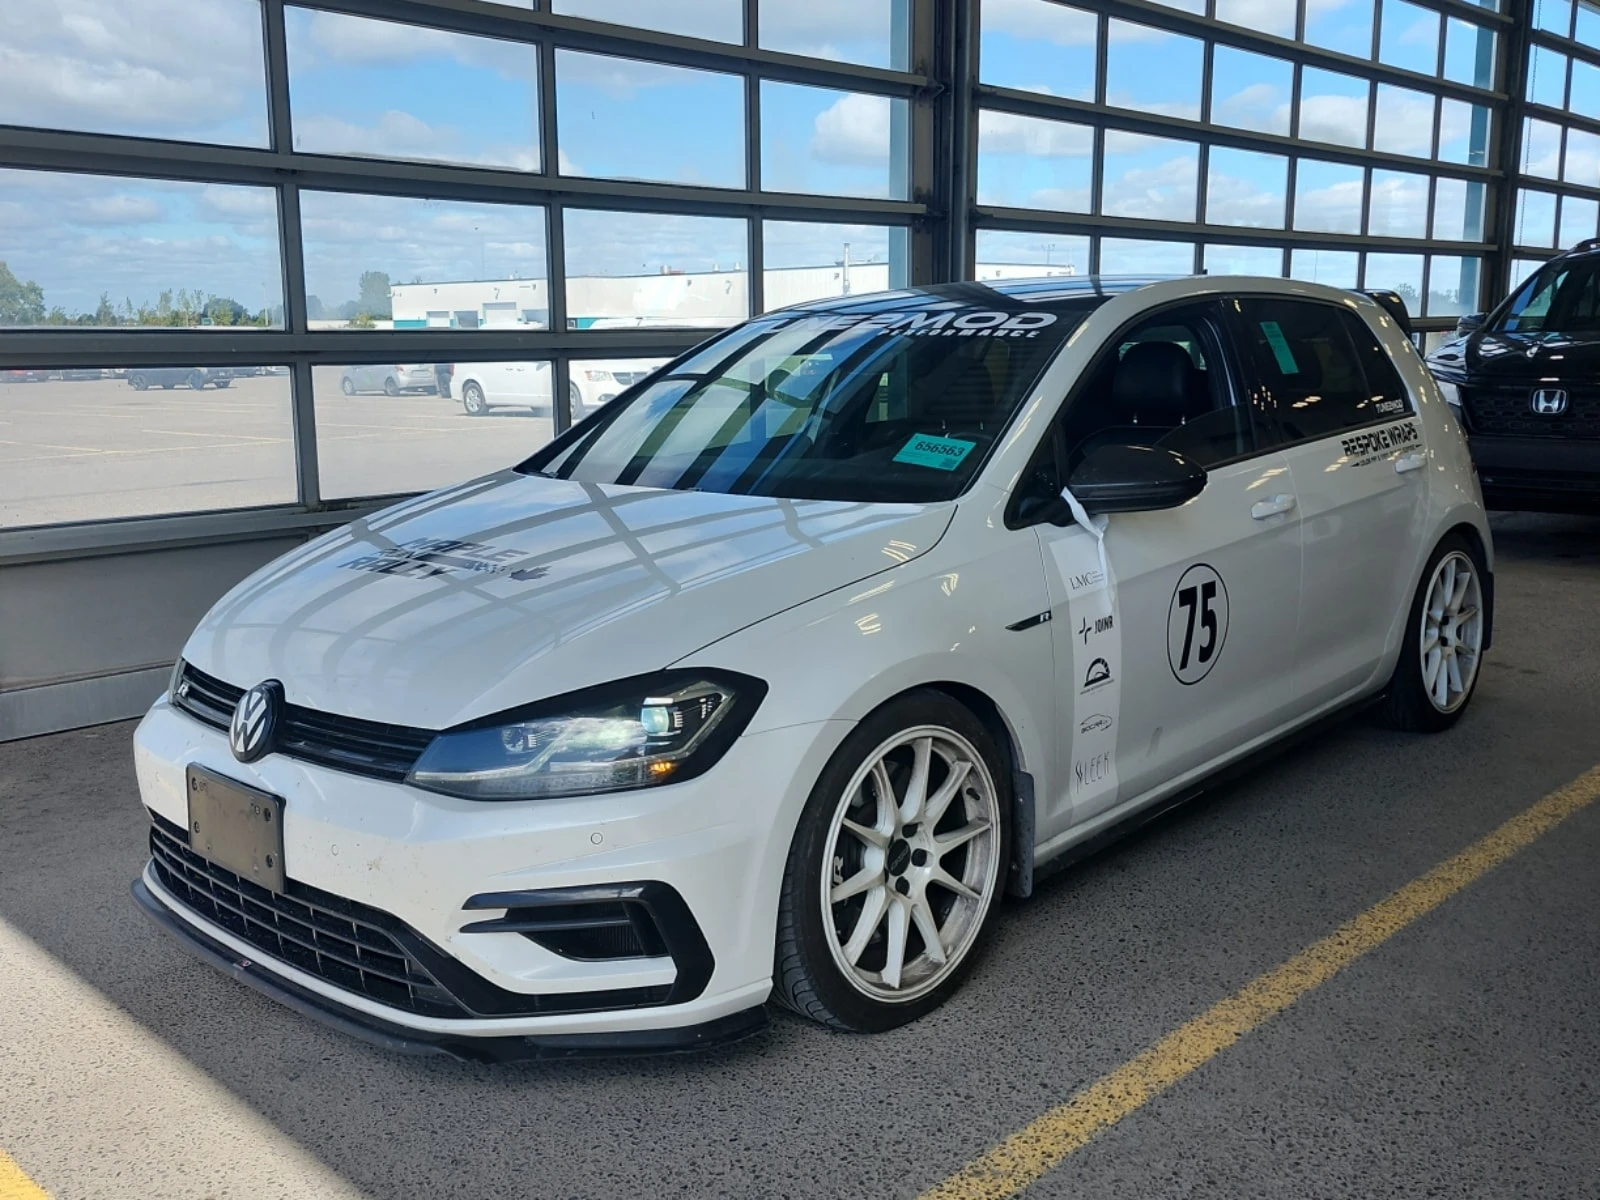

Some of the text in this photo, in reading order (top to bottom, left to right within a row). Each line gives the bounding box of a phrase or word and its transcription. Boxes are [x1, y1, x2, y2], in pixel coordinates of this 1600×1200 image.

[877, 328, 1041, 338] PERFORMANCE
[914, 441, 966, 457] 656563
[1341, 429, 1390, 456] BESPOKE
[1386, 422, 1418, 446] WRAPS
[1178, 580, 1218, 671] 75
